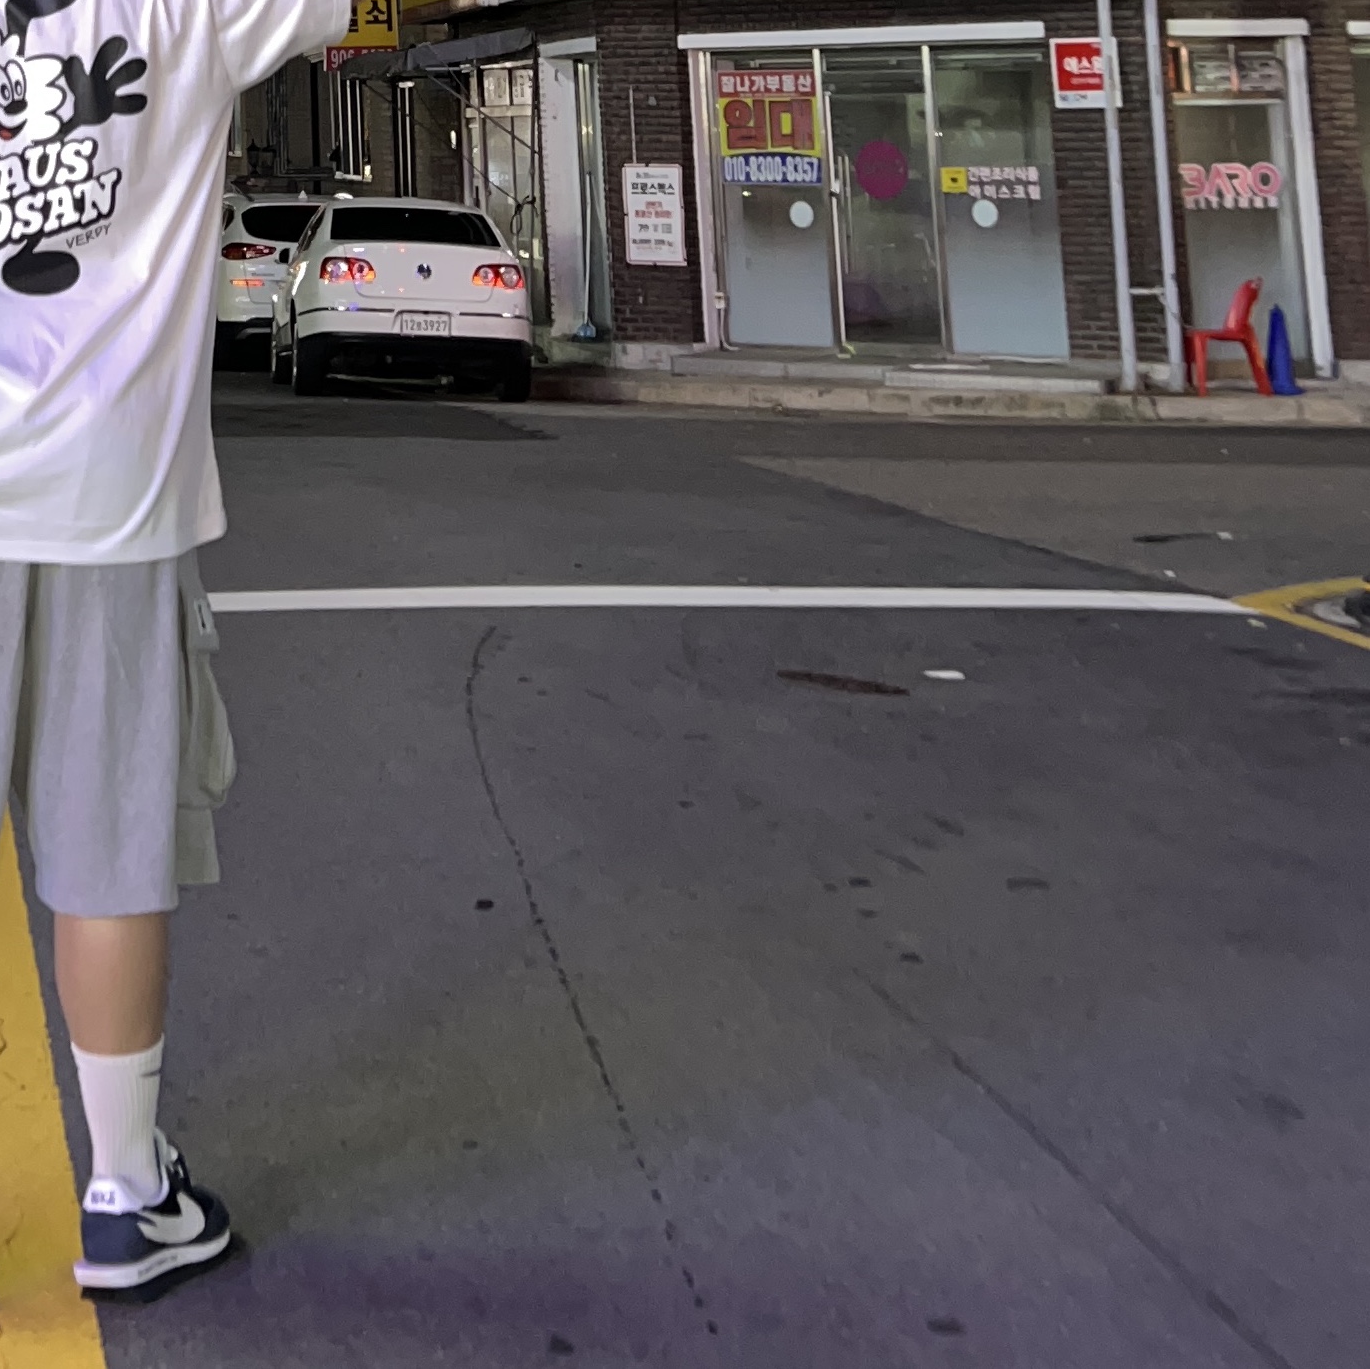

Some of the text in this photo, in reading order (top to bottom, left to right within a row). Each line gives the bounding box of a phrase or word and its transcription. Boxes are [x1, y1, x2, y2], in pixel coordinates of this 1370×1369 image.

[723, 98, 815, 150] 임대
[1178, 161, 1283, 198] BARO
[66, 223, 112, 249] VERDY
